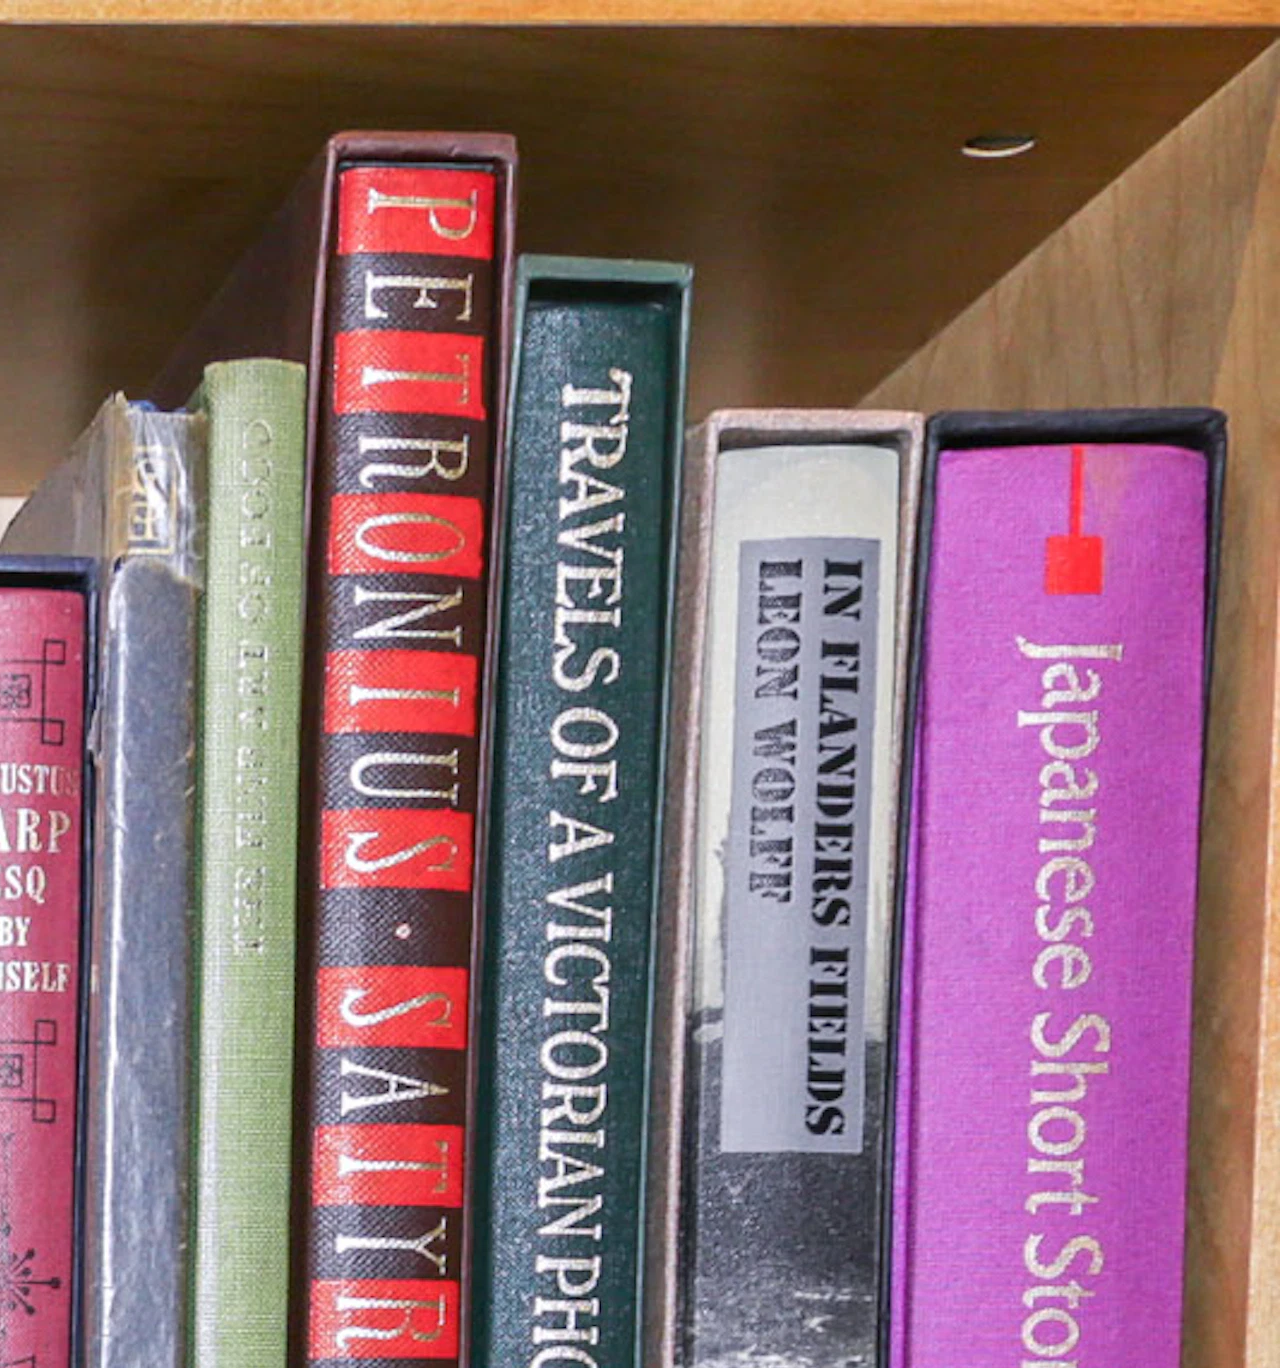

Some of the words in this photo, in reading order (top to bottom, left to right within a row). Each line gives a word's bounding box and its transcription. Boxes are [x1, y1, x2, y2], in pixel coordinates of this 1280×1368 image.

[343, 187, 478, 874] PETRONIUS
[552, 369, 632, 693] TRAVELS
[755, 561, 803, 700] LEON
[823, 560, 864, 620] IN
[548, 706, 619, 803] OF
[548, 811, 615, 859] A
[810, 641, 861, 927] FLANDERS
[1014, 634, 1121, 990] Japanese
[537, 878, 613, 1252] VICTORIAN
[805, 945, 849, 1137] FIELDS
[1025, 1012, 1110, 1216] Short
